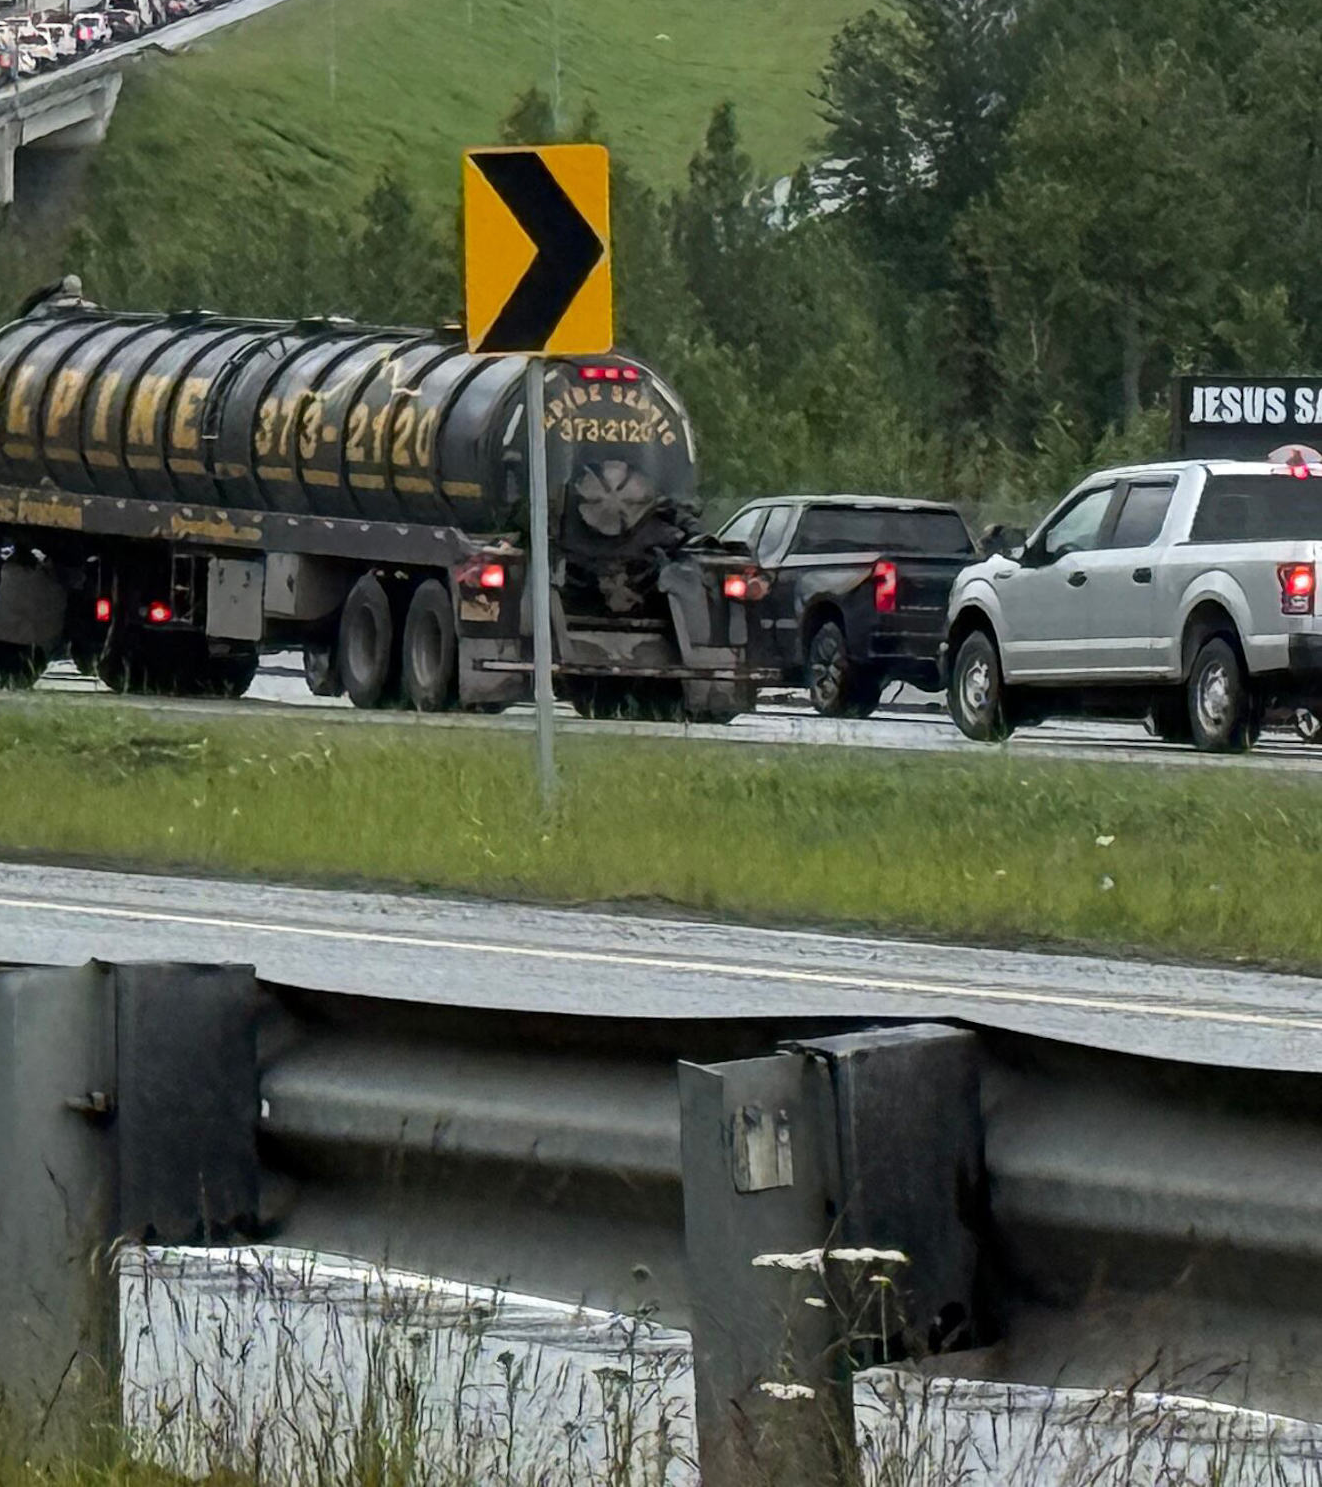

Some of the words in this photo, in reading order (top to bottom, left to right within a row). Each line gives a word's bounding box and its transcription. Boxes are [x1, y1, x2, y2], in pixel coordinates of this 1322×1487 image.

[1189, 386, 1287, 423] JESUS
[255, 389, 438, 467] 373-2120
[560, 417, 655, 443] 373-2120
